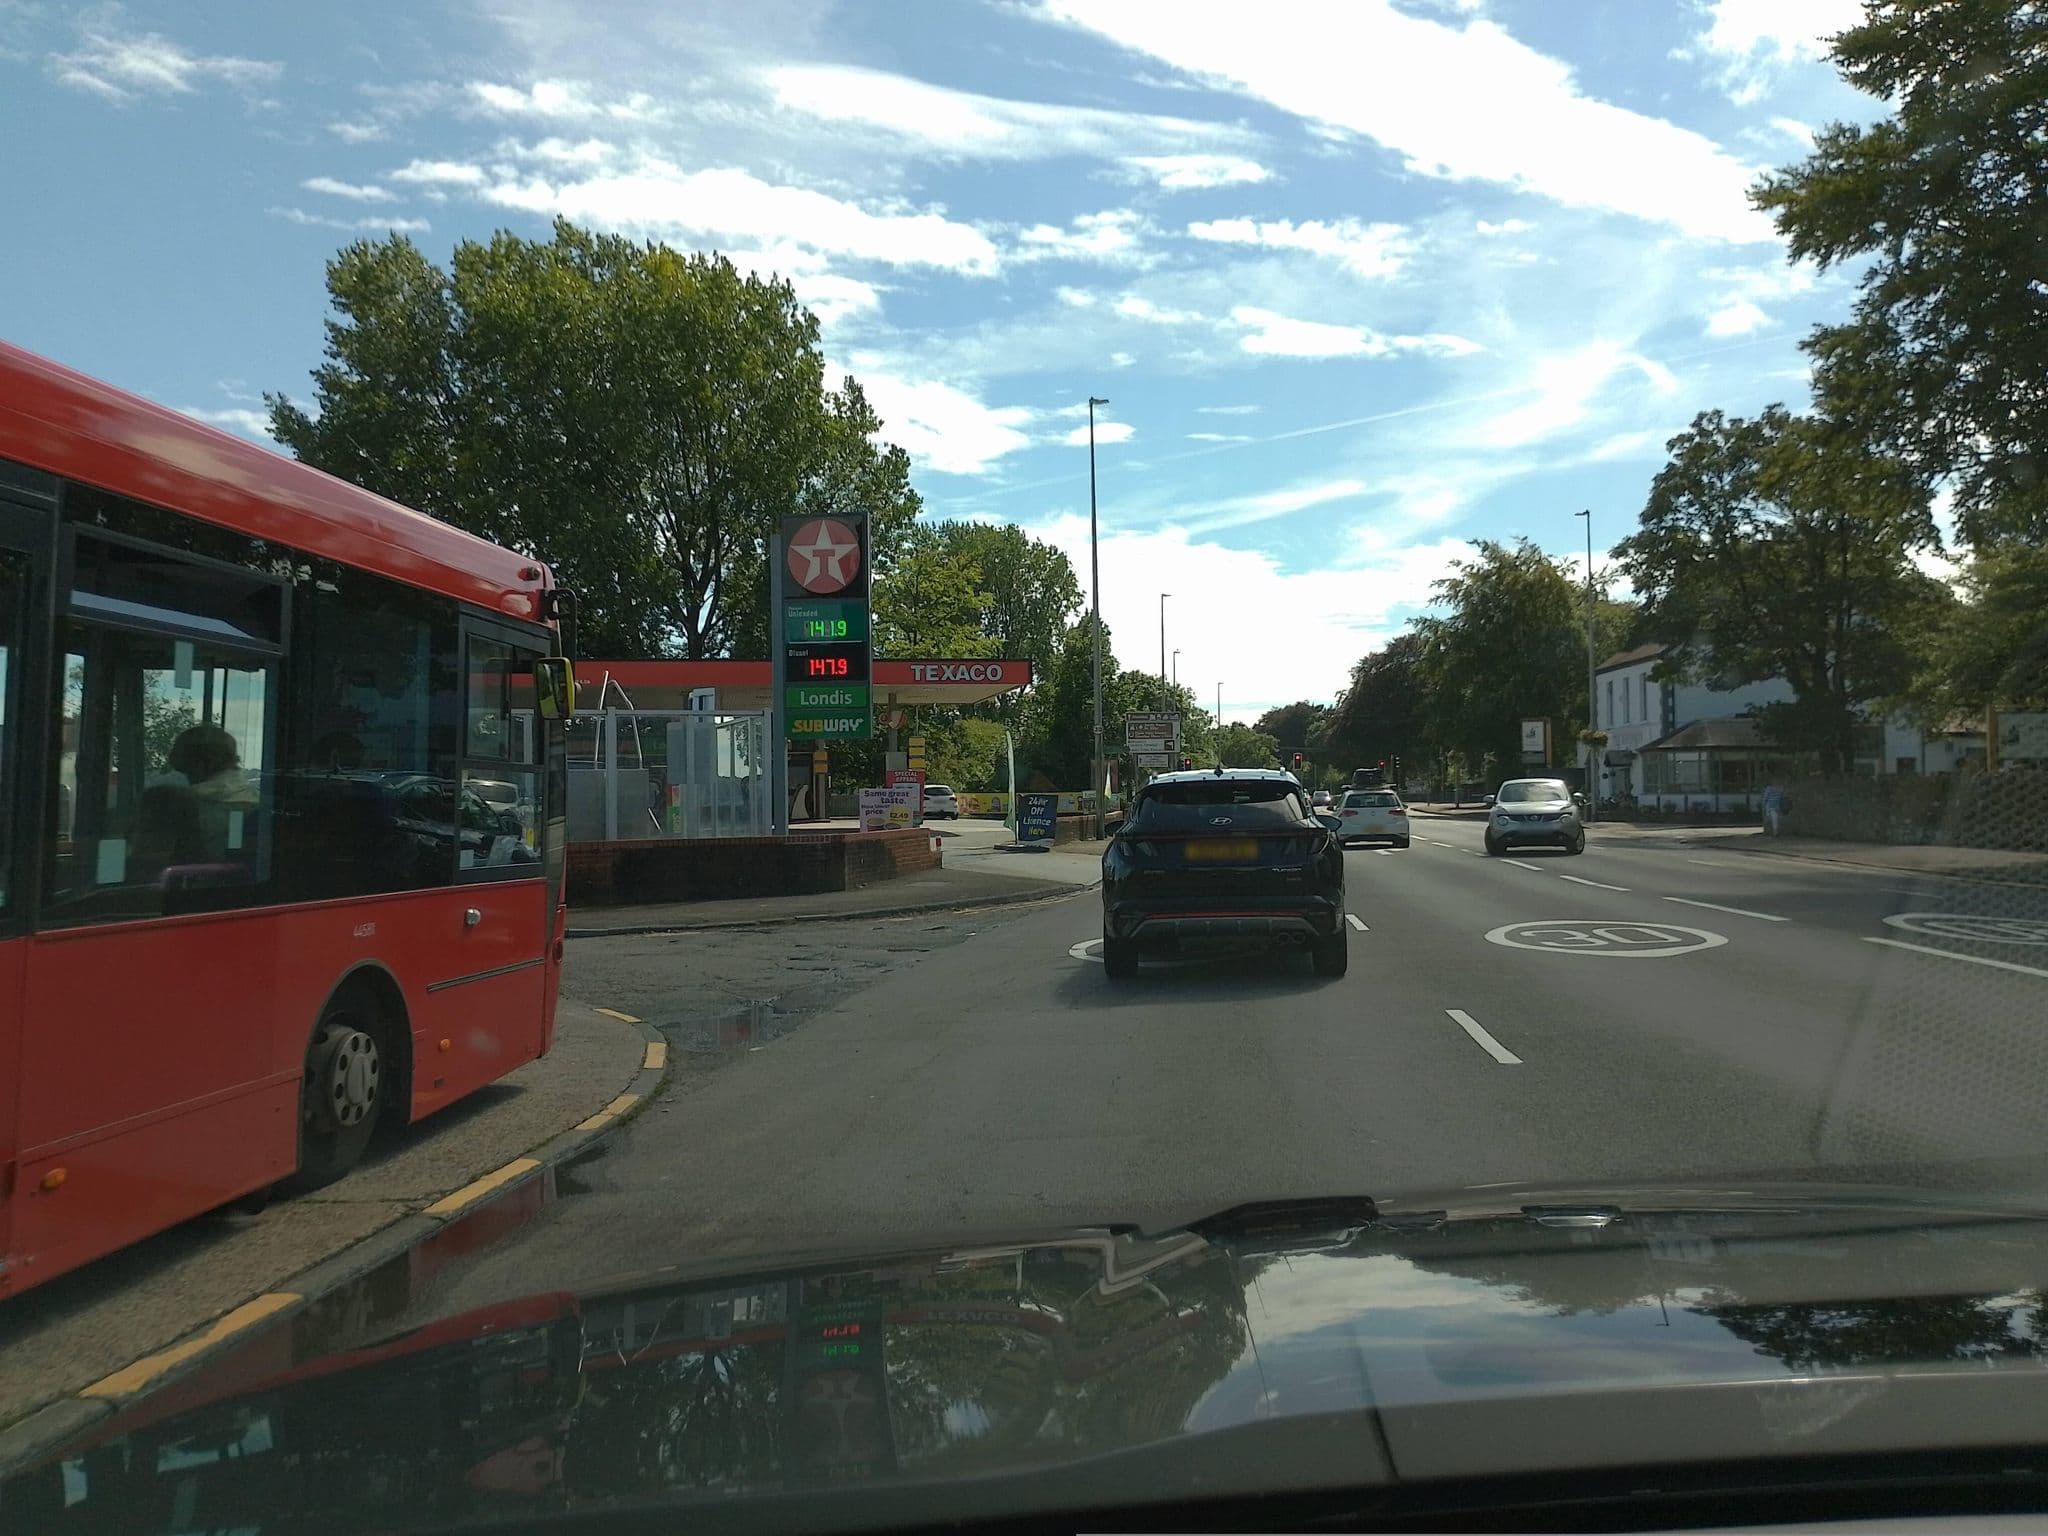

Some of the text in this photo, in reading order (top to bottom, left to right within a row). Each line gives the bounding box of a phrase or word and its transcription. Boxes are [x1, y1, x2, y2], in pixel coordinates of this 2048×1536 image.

[809, 620, 847, 637] 141.9
[788, 649, 809, 657] Diesel
[809, 659, 848, 676] 147.9
[910, 664, 1003, 681] TEXACO
[800, 690, 853, 705] Londis
[792, 718, 864, 733] SUBWAY
[888, 790, 910, 798] great
[1030, 806, 1045, 815] Off
[1022, 816, 1052, 826] Licence
[1519, 927, 1682, 947] 30
